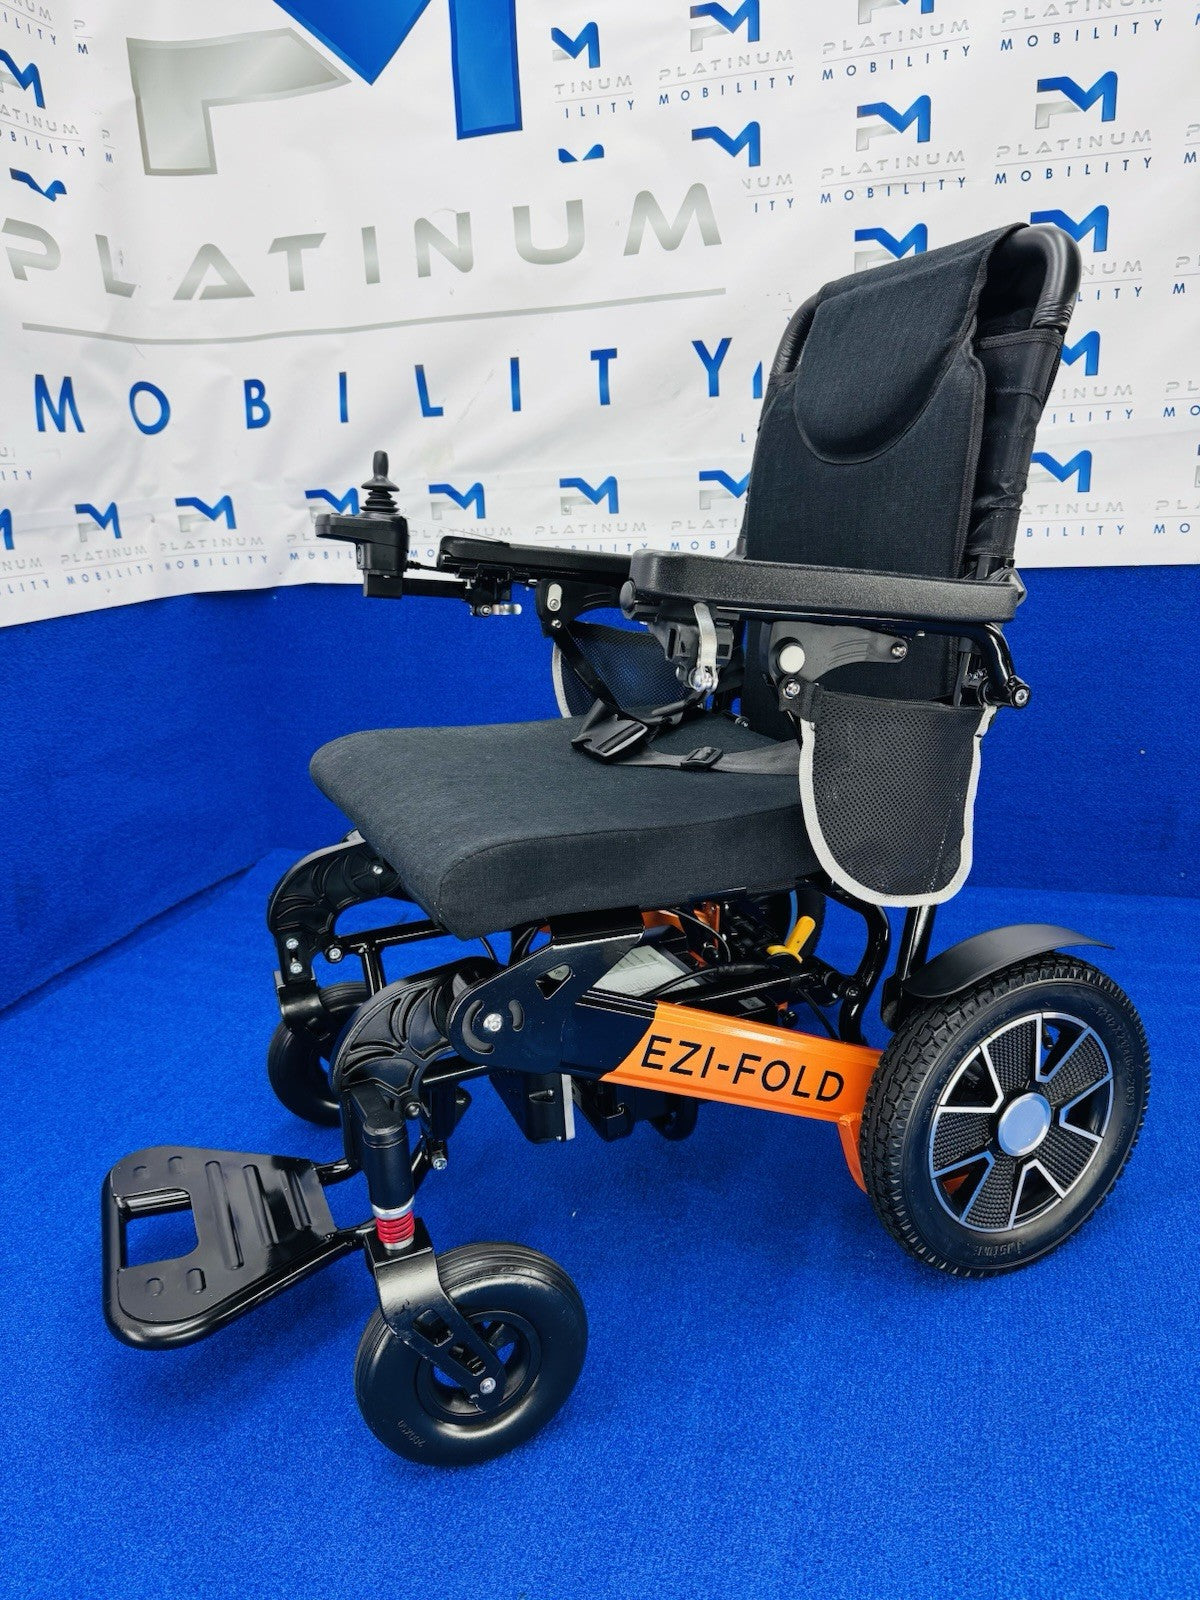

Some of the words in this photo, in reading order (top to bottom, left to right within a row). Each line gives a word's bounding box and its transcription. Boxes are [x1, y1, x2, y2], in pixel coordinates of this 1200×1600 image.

[1001, 0, 1162, 24] PLATINU
[822, 19, 970, 55] PLATINUM
[1000, 19, 1162, 51] MOBILITY
[659, 49, 793, 81] PLATINUM
[822, 45, 970, 81] MOBILITY
[658, 74, 795, 105] MOBILITY
[996, 129, 1152, 158] PLATINUM
[821, 150, 965, 180] PLATINUM
[995, 157, 1152, 185] MOBILITY
[820, 177, 966, 204] MOBILITY
[1, 182, 722, 301] PLATINUM
[34, 337, 733, 435] MOBILITY
[534, 521, 647, 536] PLATINUM
[60, 545, 148, 565] PLATINUM
[159, 536, 265, 552] PLATINUM
[66, 564, 154, 586] MOBILITY
[165, 554, 268, 571] MOBILITY
[641, 1034, 845, 1102] EZI-FOLD
